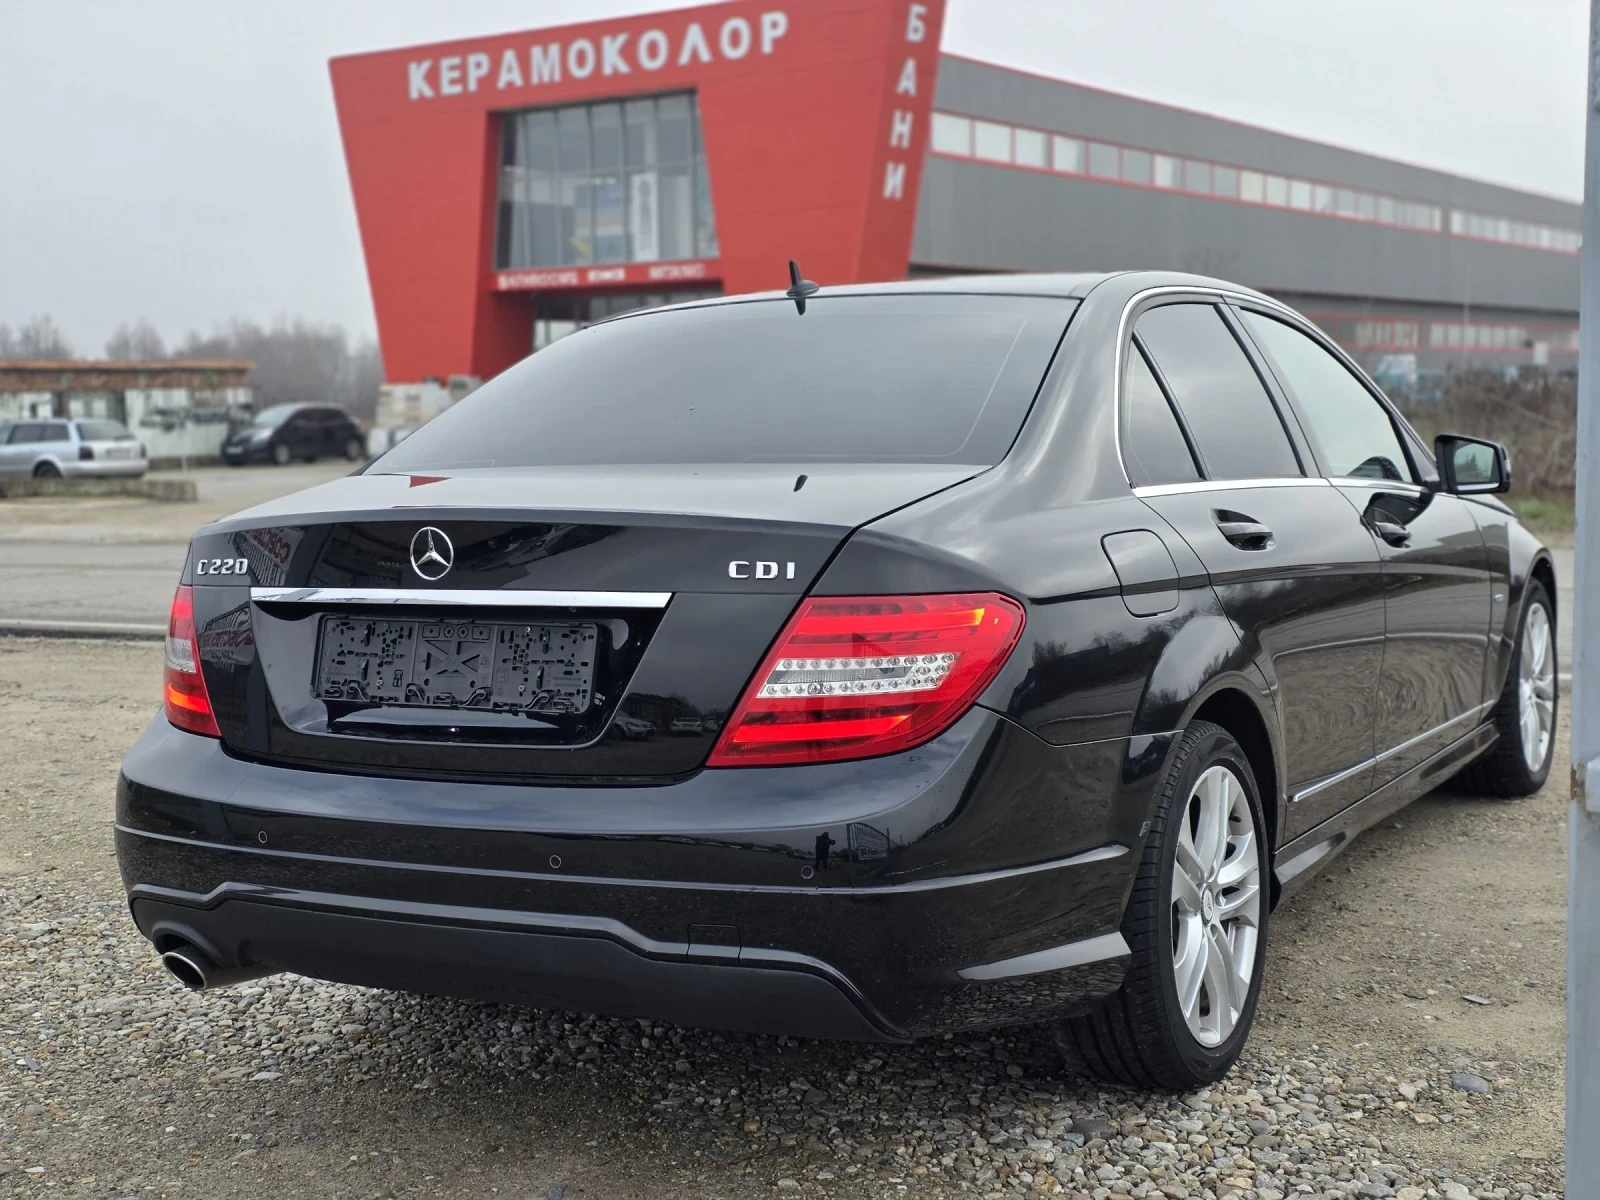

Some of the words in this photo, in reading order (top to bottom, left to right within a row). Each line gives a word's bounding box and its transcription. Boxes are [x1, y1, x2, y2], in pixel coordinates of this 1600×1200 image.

[407, 11, 789, 100] КЕРАМОКОЛОР
[882, 3, 928, 201] БАНИ
[196, 557, 249, 576] C220
[728, 560, 796, 580] CDI
